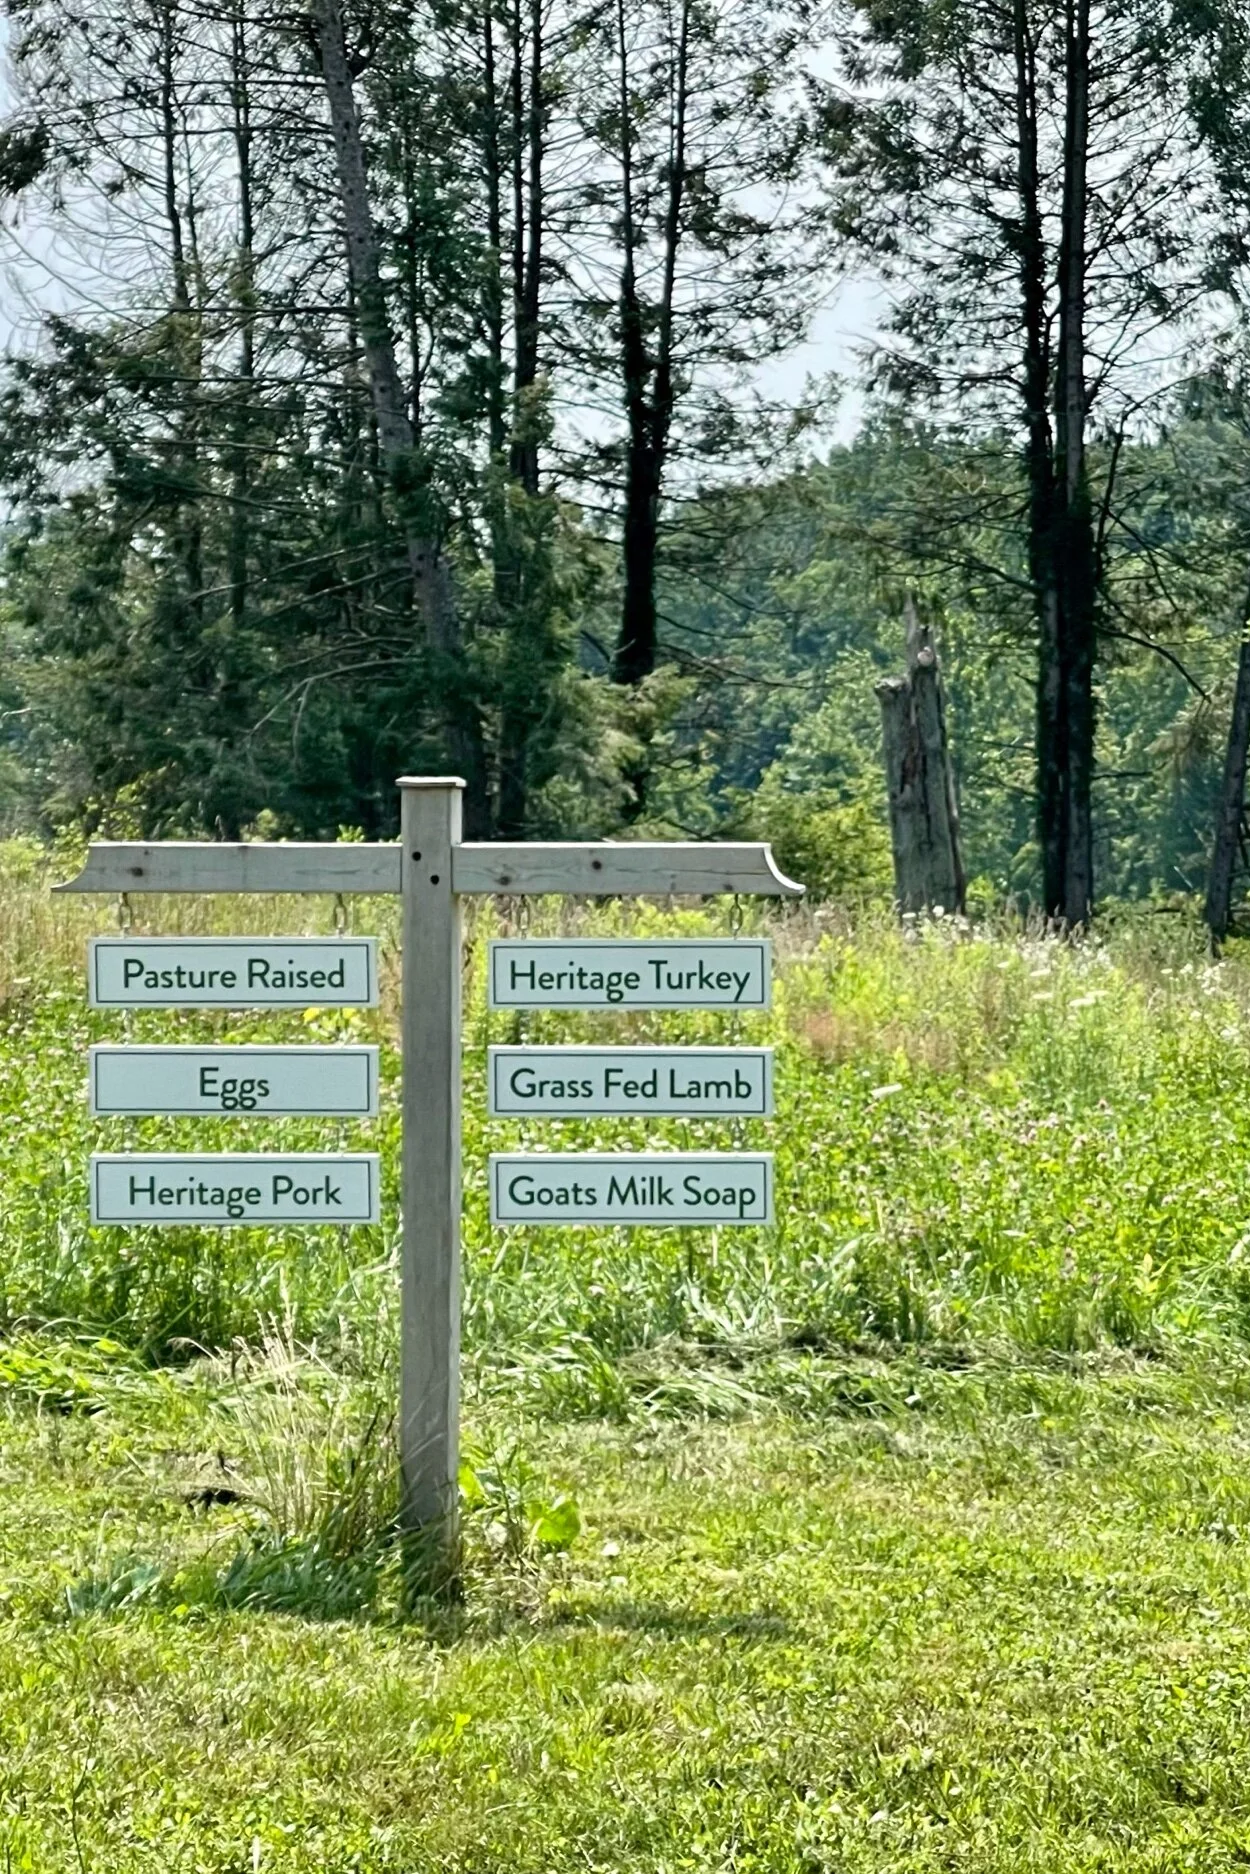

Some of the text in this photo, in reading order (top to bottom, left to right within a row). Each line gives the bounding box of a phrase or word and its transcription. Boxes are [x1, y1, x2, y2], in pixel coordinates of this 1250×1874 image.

[123, 958, 345, 989] Pasture Raised
[509, 960, 751, 1001] Heritage Turkey
[199, 1067, 269, 1109] Eggs
[509, 1068, 752, 1098] Grass Fed Lamb
[129, 1176, 341, 1216] Heritage Pork
[508, 1176, 755, 1217] Goats Milk Soap
